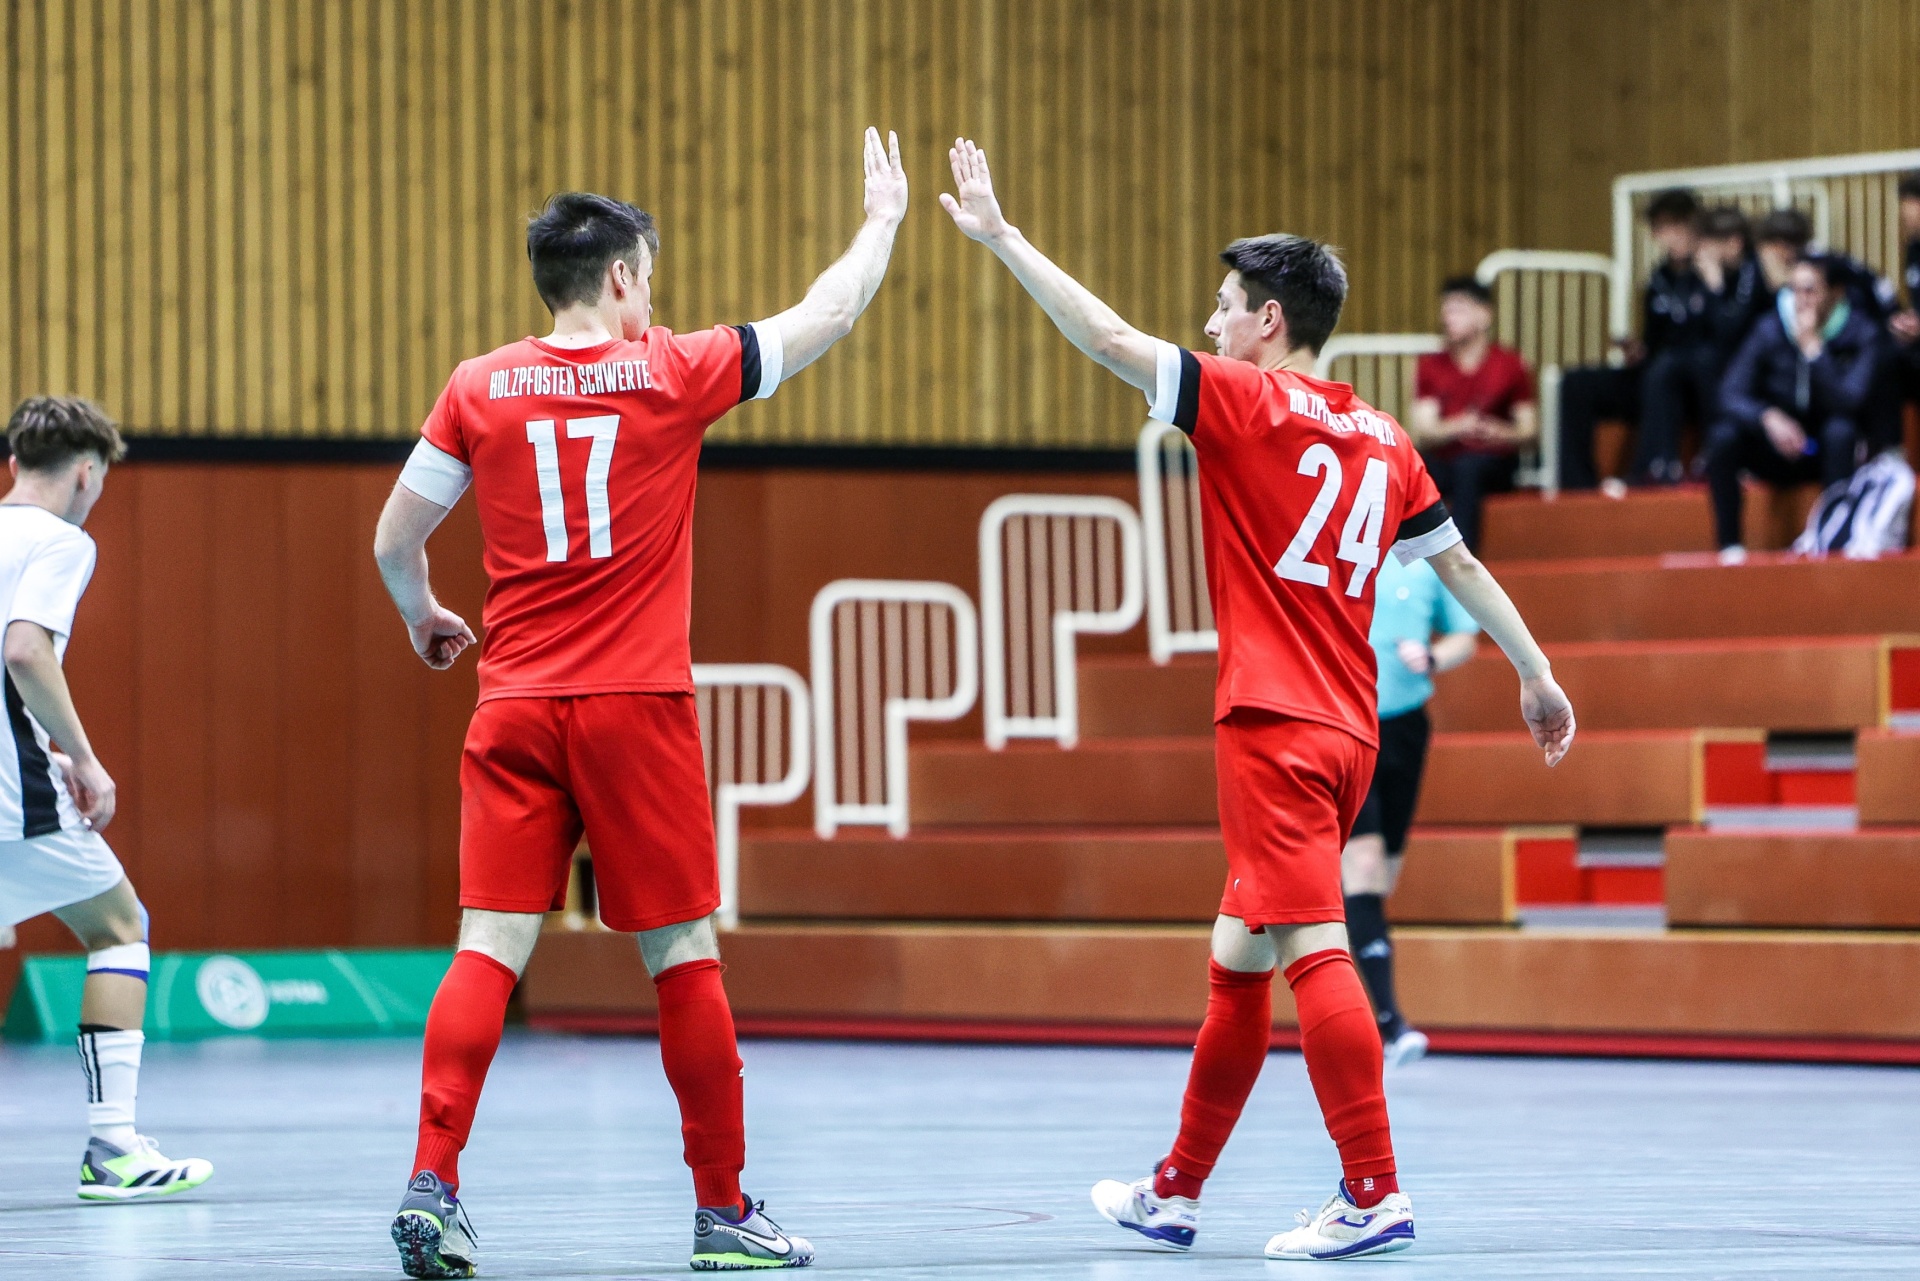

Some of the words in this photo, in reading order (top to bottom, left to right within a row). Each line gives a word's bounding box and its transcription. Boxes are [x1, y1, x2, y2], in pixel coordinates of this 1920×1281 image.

[489, 365, 576, 400] HOLZPFOSTEN
[577, 360, 652, 396] SCHWERTE
[525, 414, 621, 562] 17
[1273, 443, 1388, 598] 24
